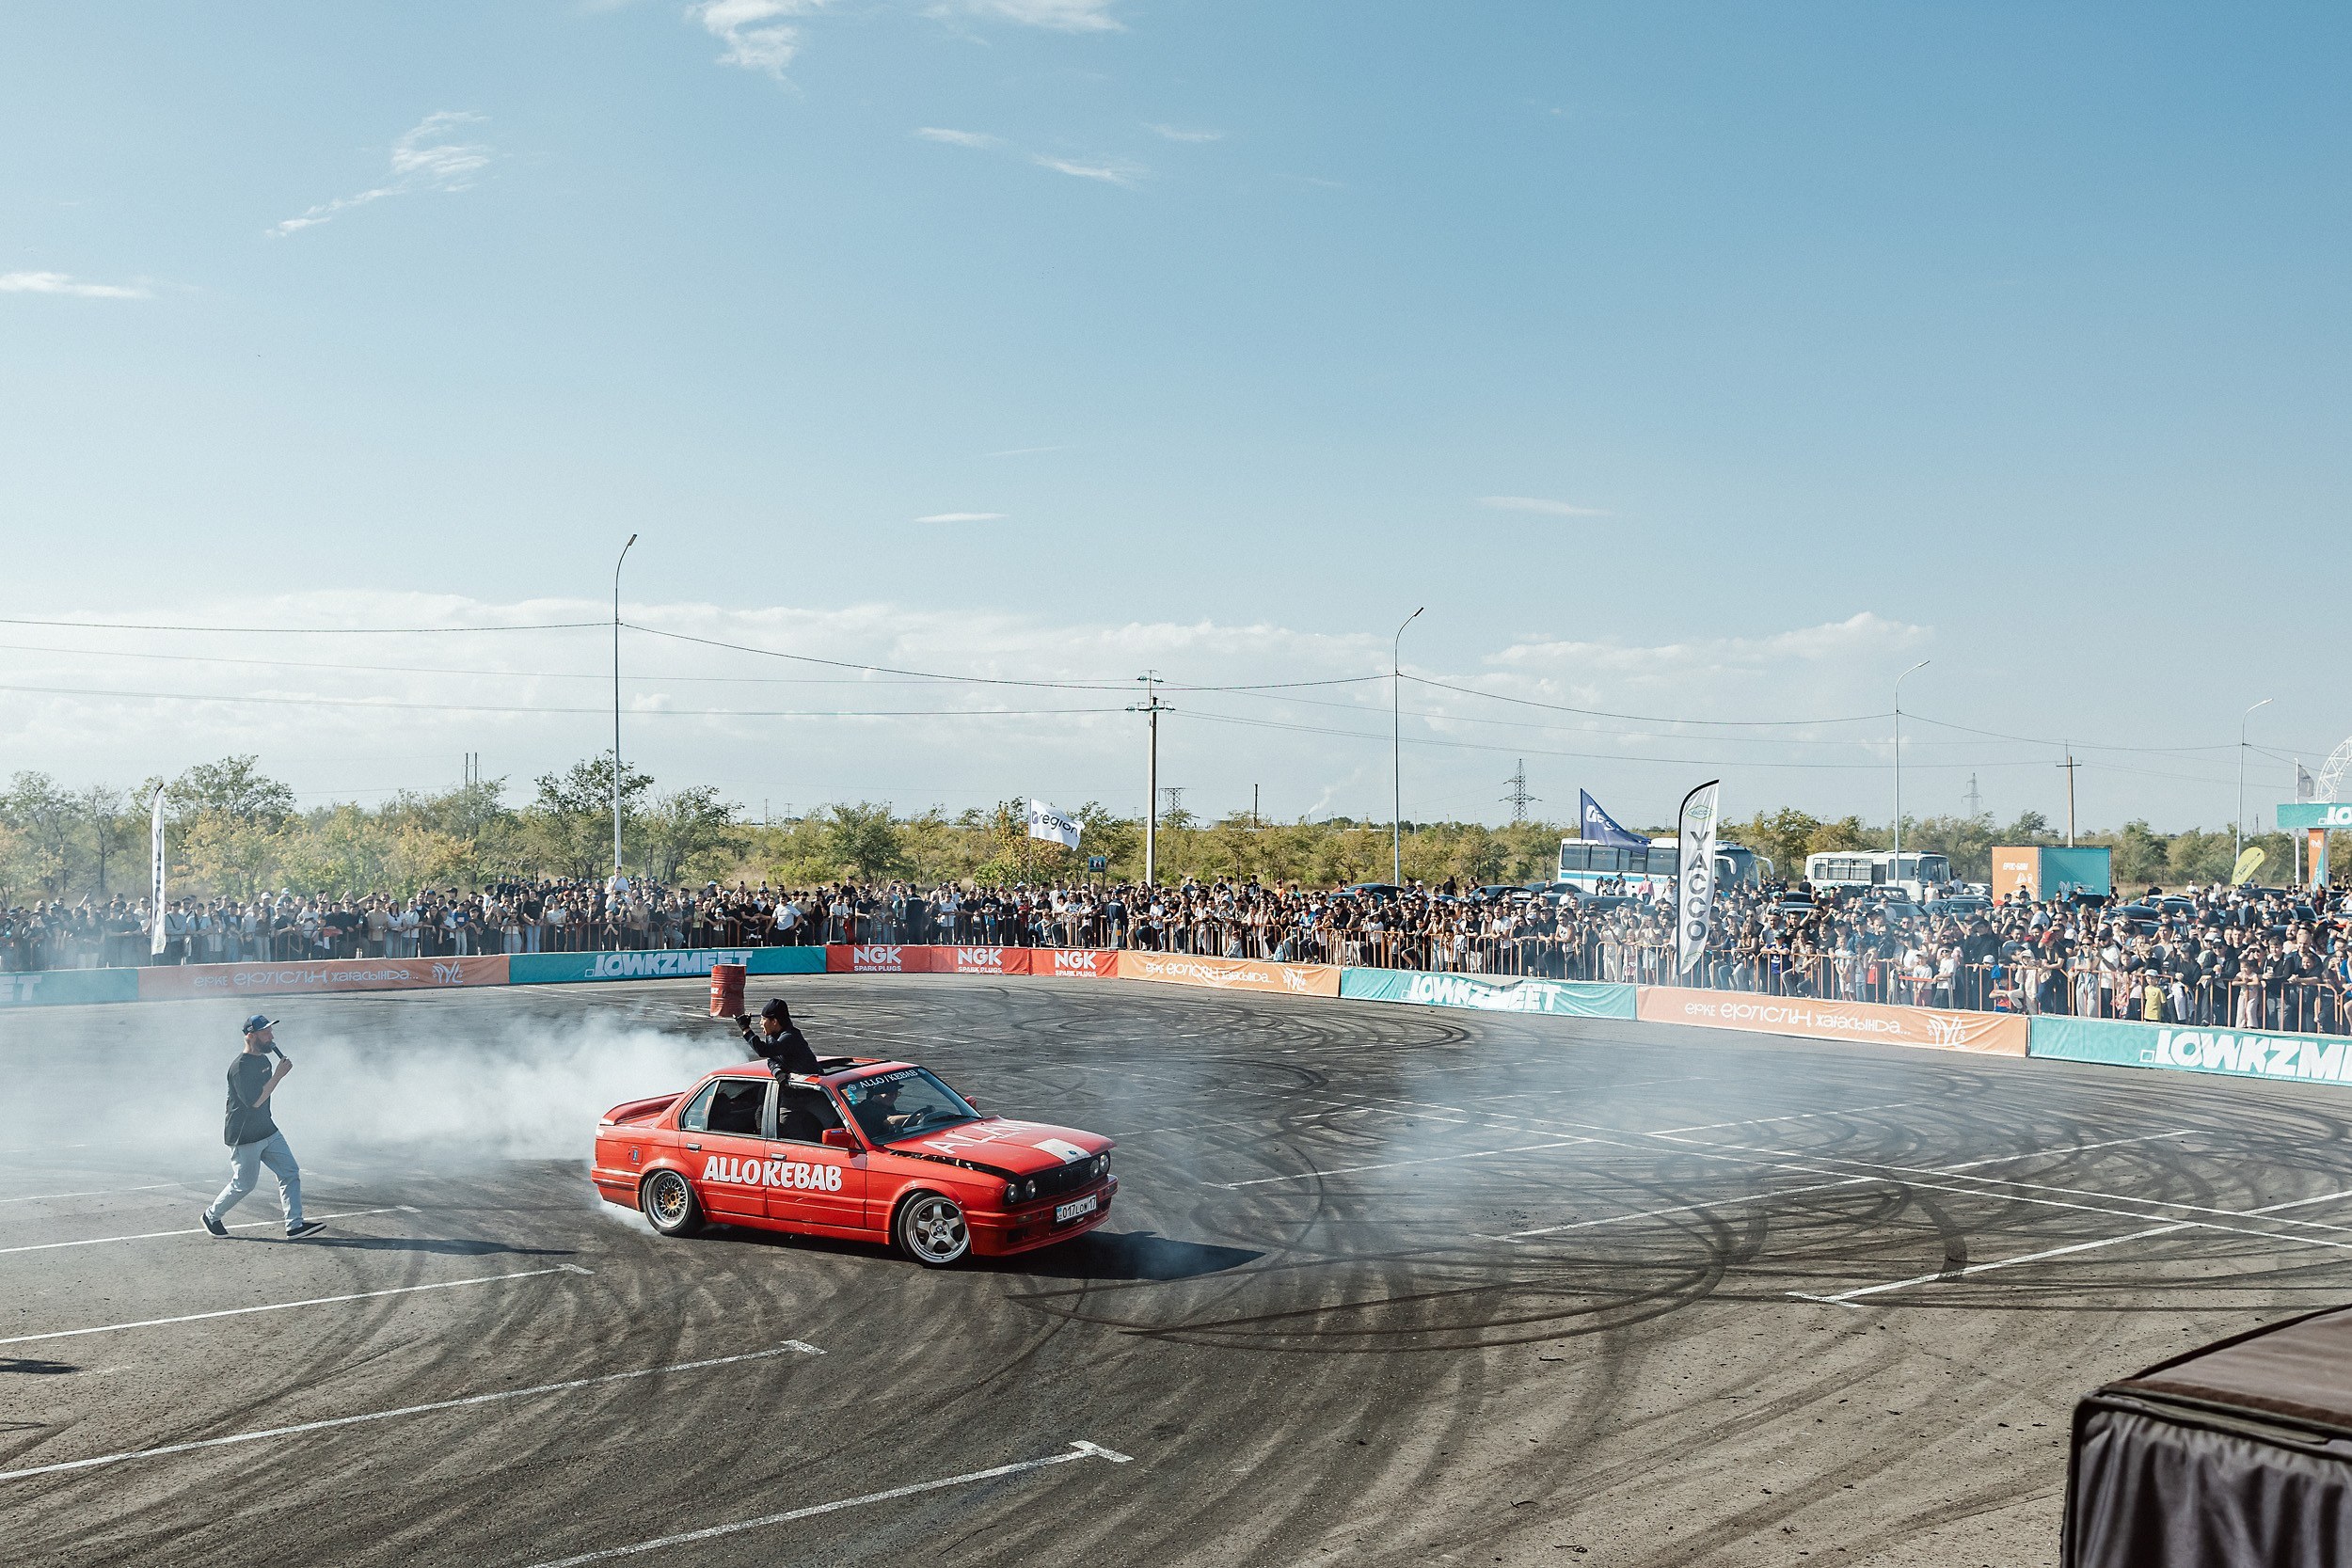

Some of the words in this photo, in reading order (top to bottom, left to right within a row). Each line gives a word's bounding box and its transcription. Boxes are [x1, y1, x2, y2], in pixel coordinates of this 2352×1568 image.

[1039, 814, 1078, 837] region
[1686, 831, 1711, 942] YACCO
[853, 946, 902, 964] NGK
[957, 947, 1003, 966] NGK
[1055, 950, 1097, 970] NGK
[859, 1076, 885, 1088] ALLO
[886, 1069, 918, 1081] KEBAB
